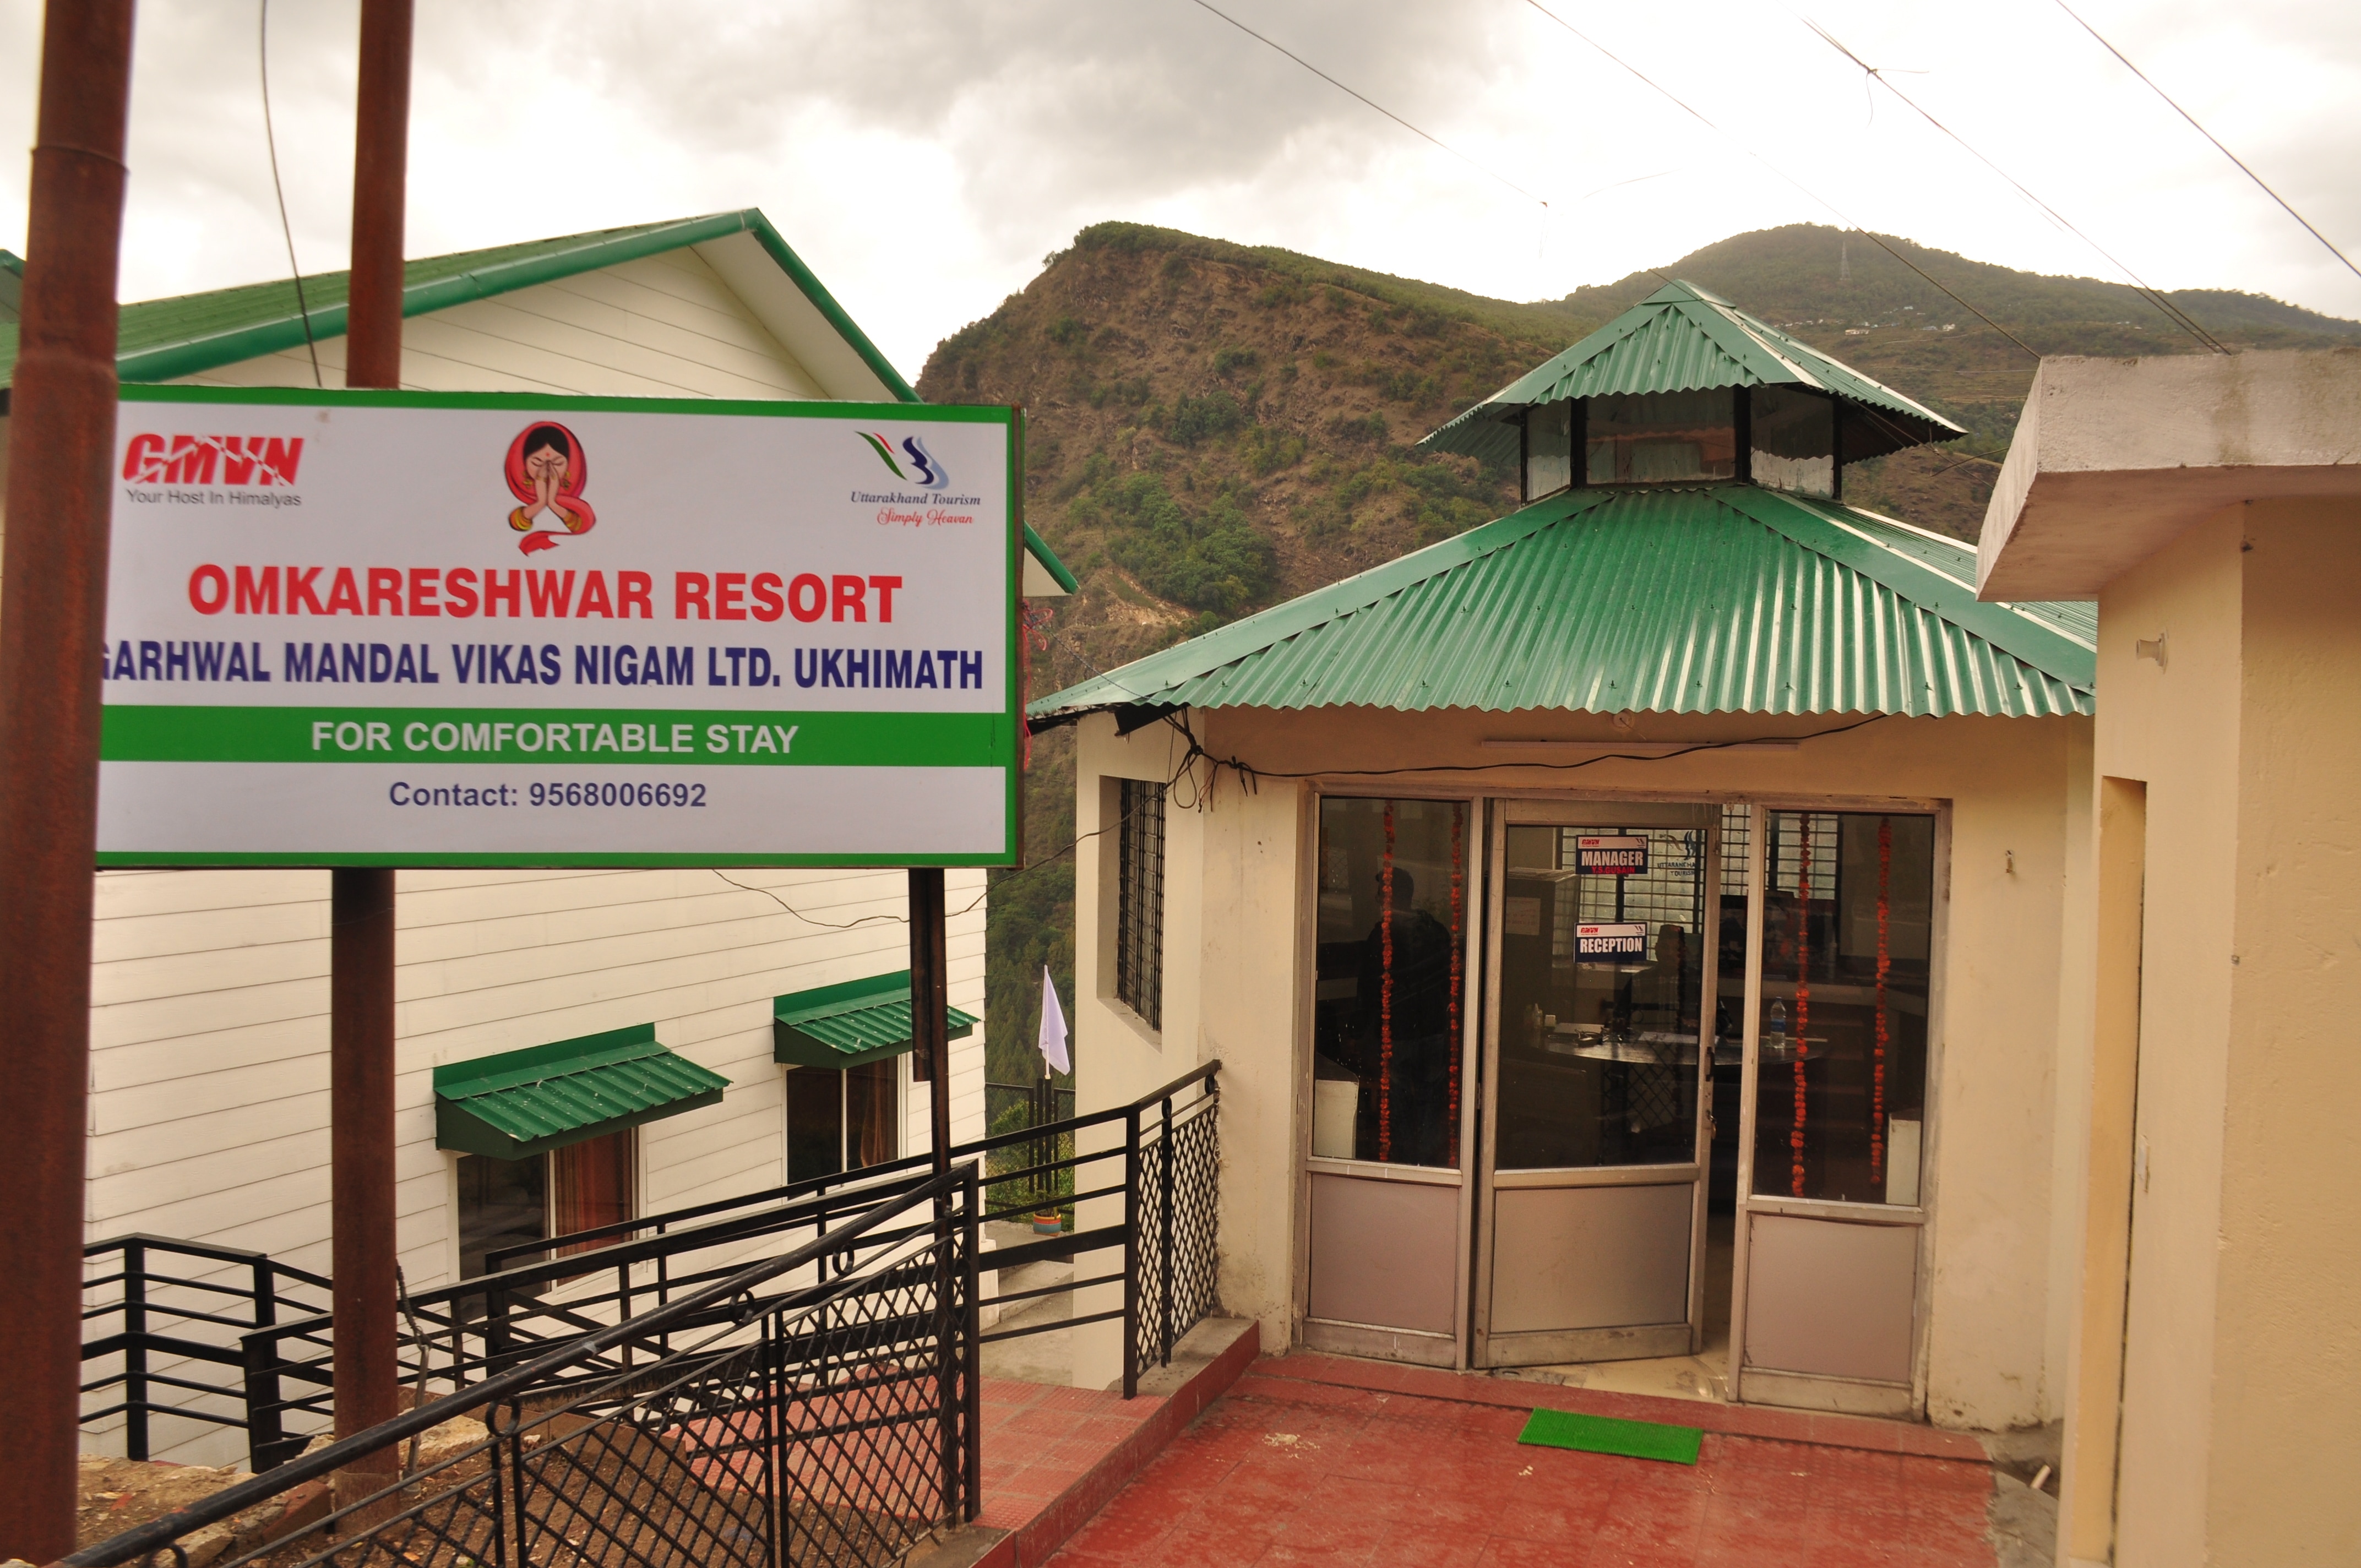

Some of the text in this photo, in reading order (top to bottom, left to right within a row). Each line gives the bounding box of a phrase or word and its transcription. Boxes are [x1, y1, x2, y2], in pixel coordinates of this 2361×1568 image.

[122, 433, 304, 487] GMVN
[127, 489, 301, 509] Your Host In Himalyas
[851, 491, 981, 505] Uttarakhand Tourism
[877, 508, 922, 527] Simply
[188, 564, 902, 623] OMKARESHWAR RESORT
[285, 643, 439, 683] MANDAL
[452, 644, 561, 685] VIKAS
[575, 645, 694, 686] NIGAM
[708, 646, 780, 687] LTD.
[795, 648, 982, 689] UKHIMATH
[312, 721, 799, 754] FOR COMFORTABLE STAY
[389, 781, 706, 807] Contact: 9568006692
[1581, 851, 1643, 866] MANAGER
[1580, 938, 1642, 953] RECEPTION
